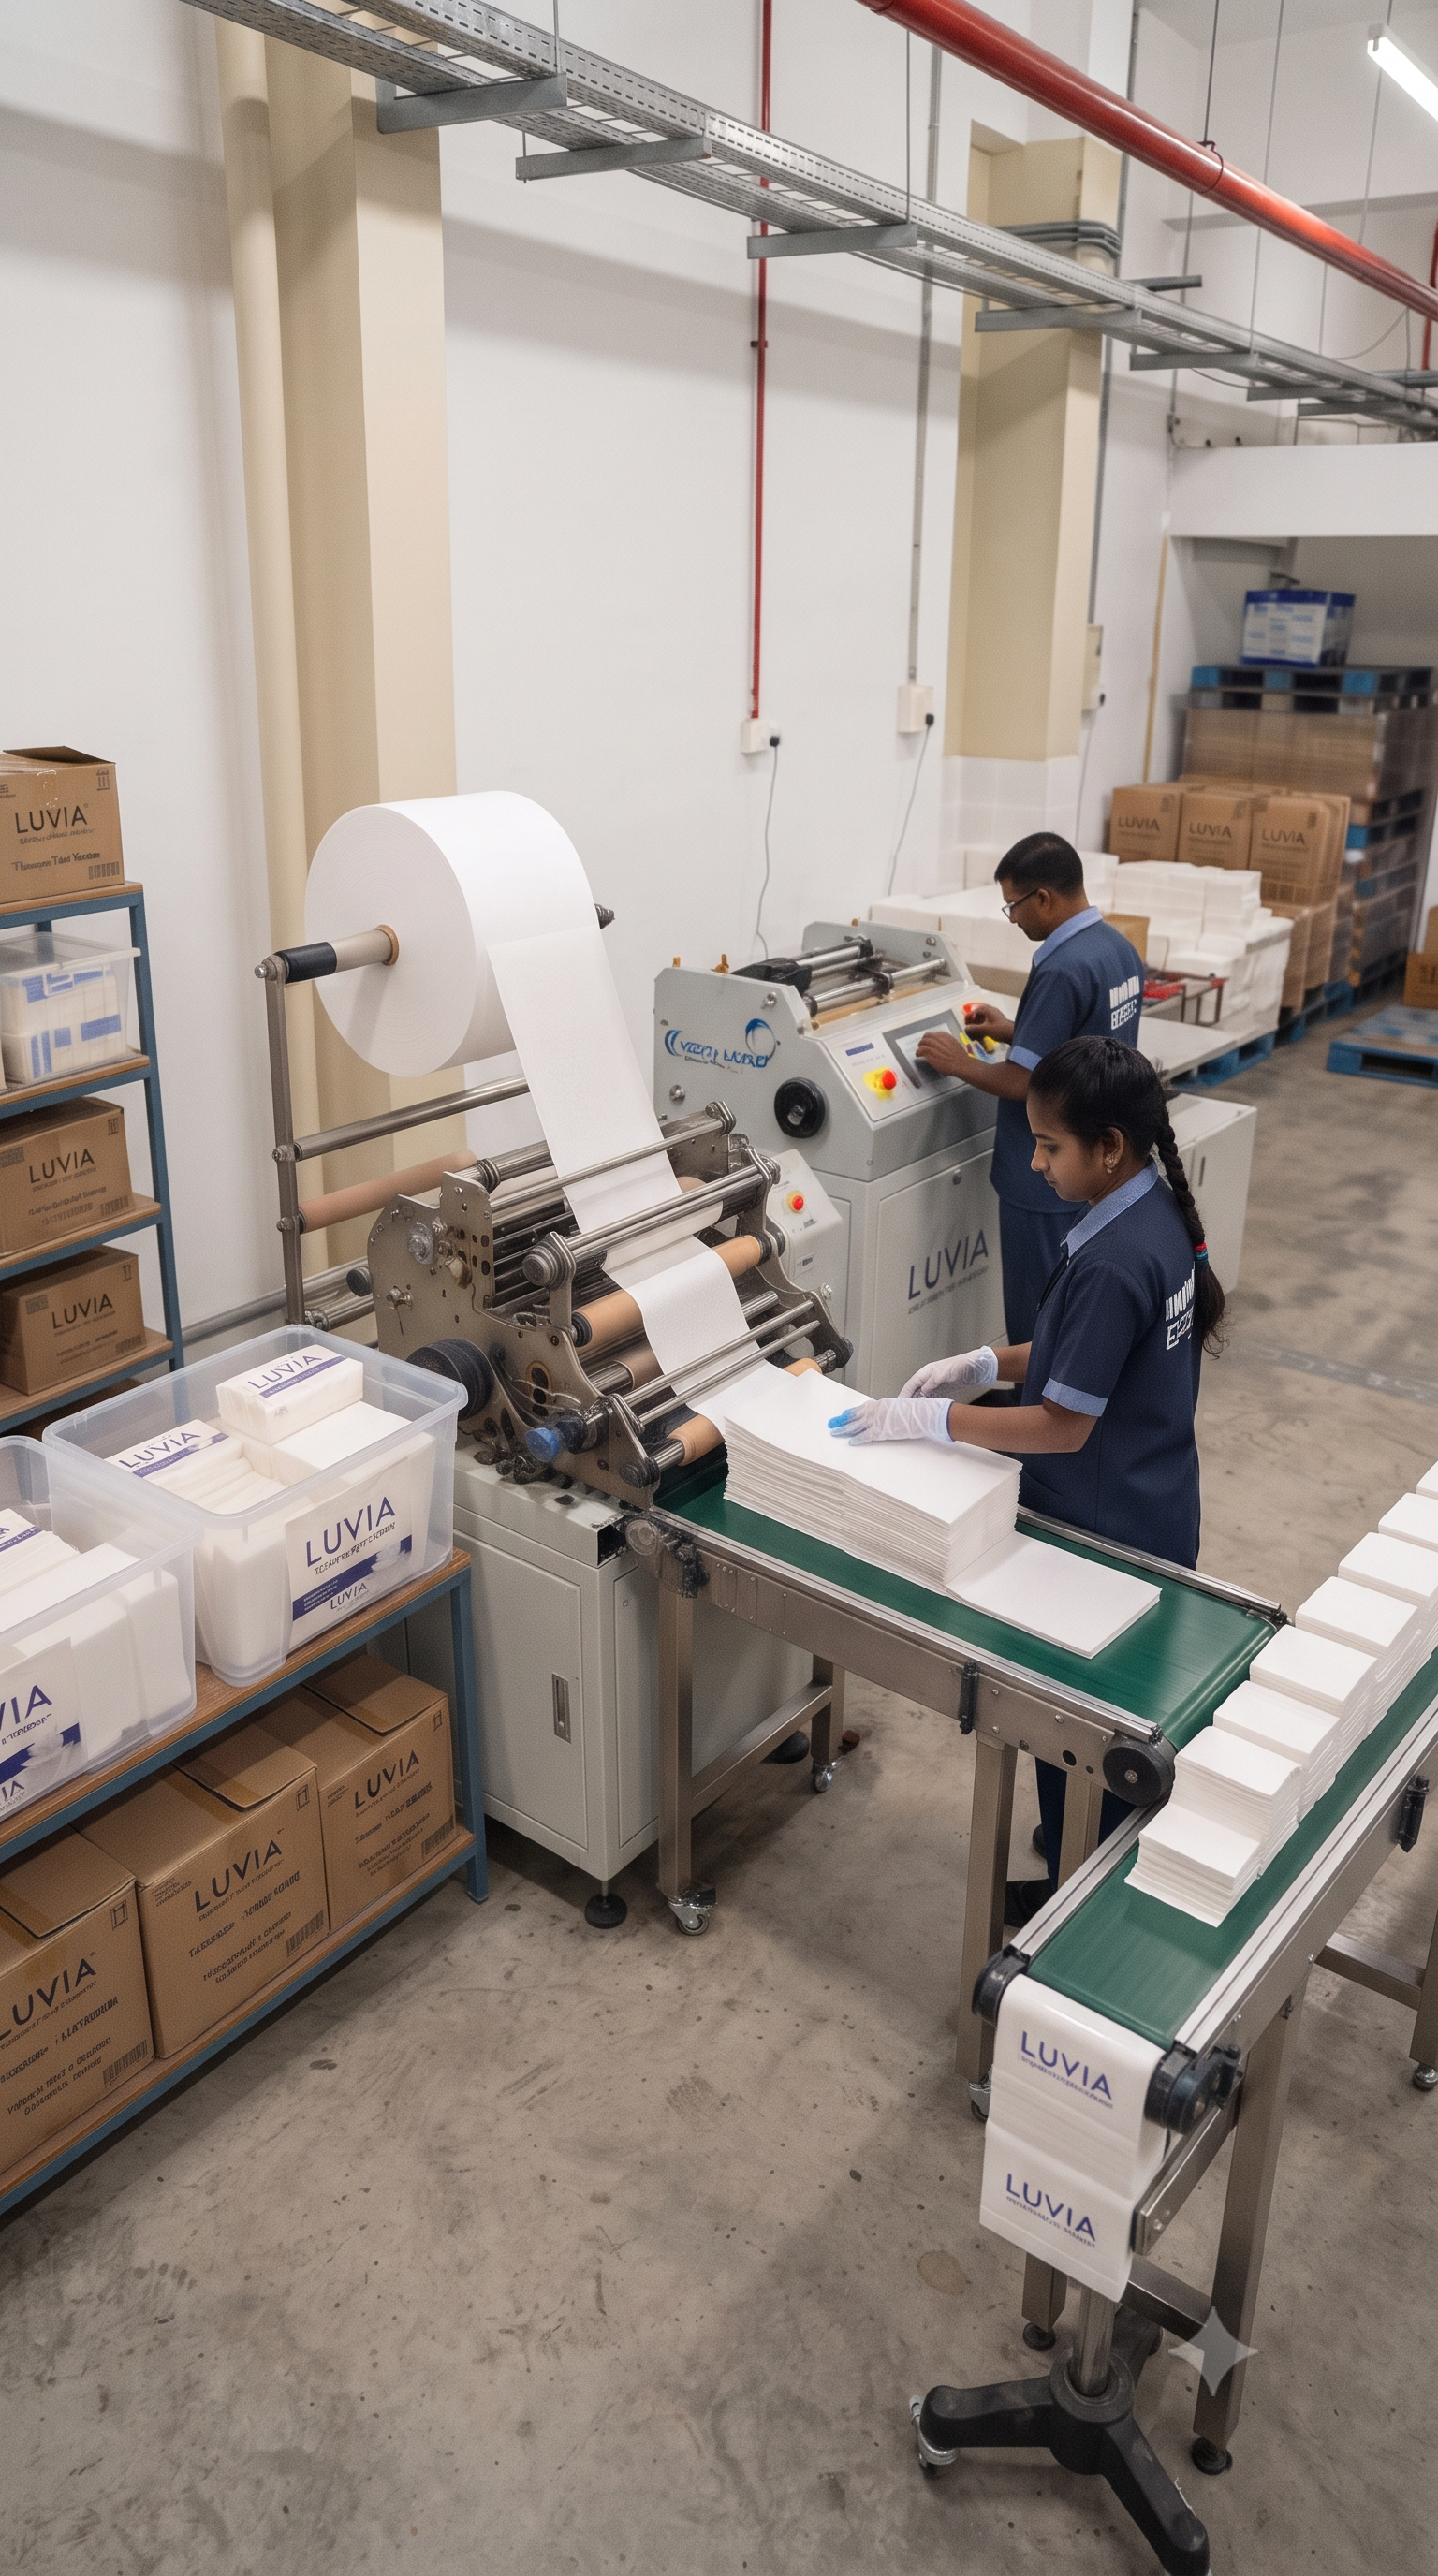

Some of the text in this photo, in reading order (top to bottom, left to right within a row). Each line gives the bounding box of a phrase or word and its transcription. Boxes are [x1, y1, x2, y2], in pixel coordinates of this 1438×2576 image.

[15, 805, 88, 834] LUVIA
[1118, 816, 1160, 833] LUVIA
[1189, 821, 1232, 839] LUVIA
[1261, 828, 1305, 846] LUVIA
[29, 1149, 95, 1184] LUVIA
[908, 1228, 989, 1300] LUVIA
[51, 1293, 113, 1329] LUVIA
[247, 1355, 322, 1389] LUVIA
[119, 1432, 201, 1469] LUVIA
[306, 1496, 396, 1568] LUVIA
[330, 1582, 368, 1610] LUVIA
[355, 1749, 419, 1810] LUVIA
[195, 1839, 282, 1913] LUVIA
[1020, 2030, 1112, 2100] LUVIA
[1006, 2173, 1096, 2242] LUVIA
